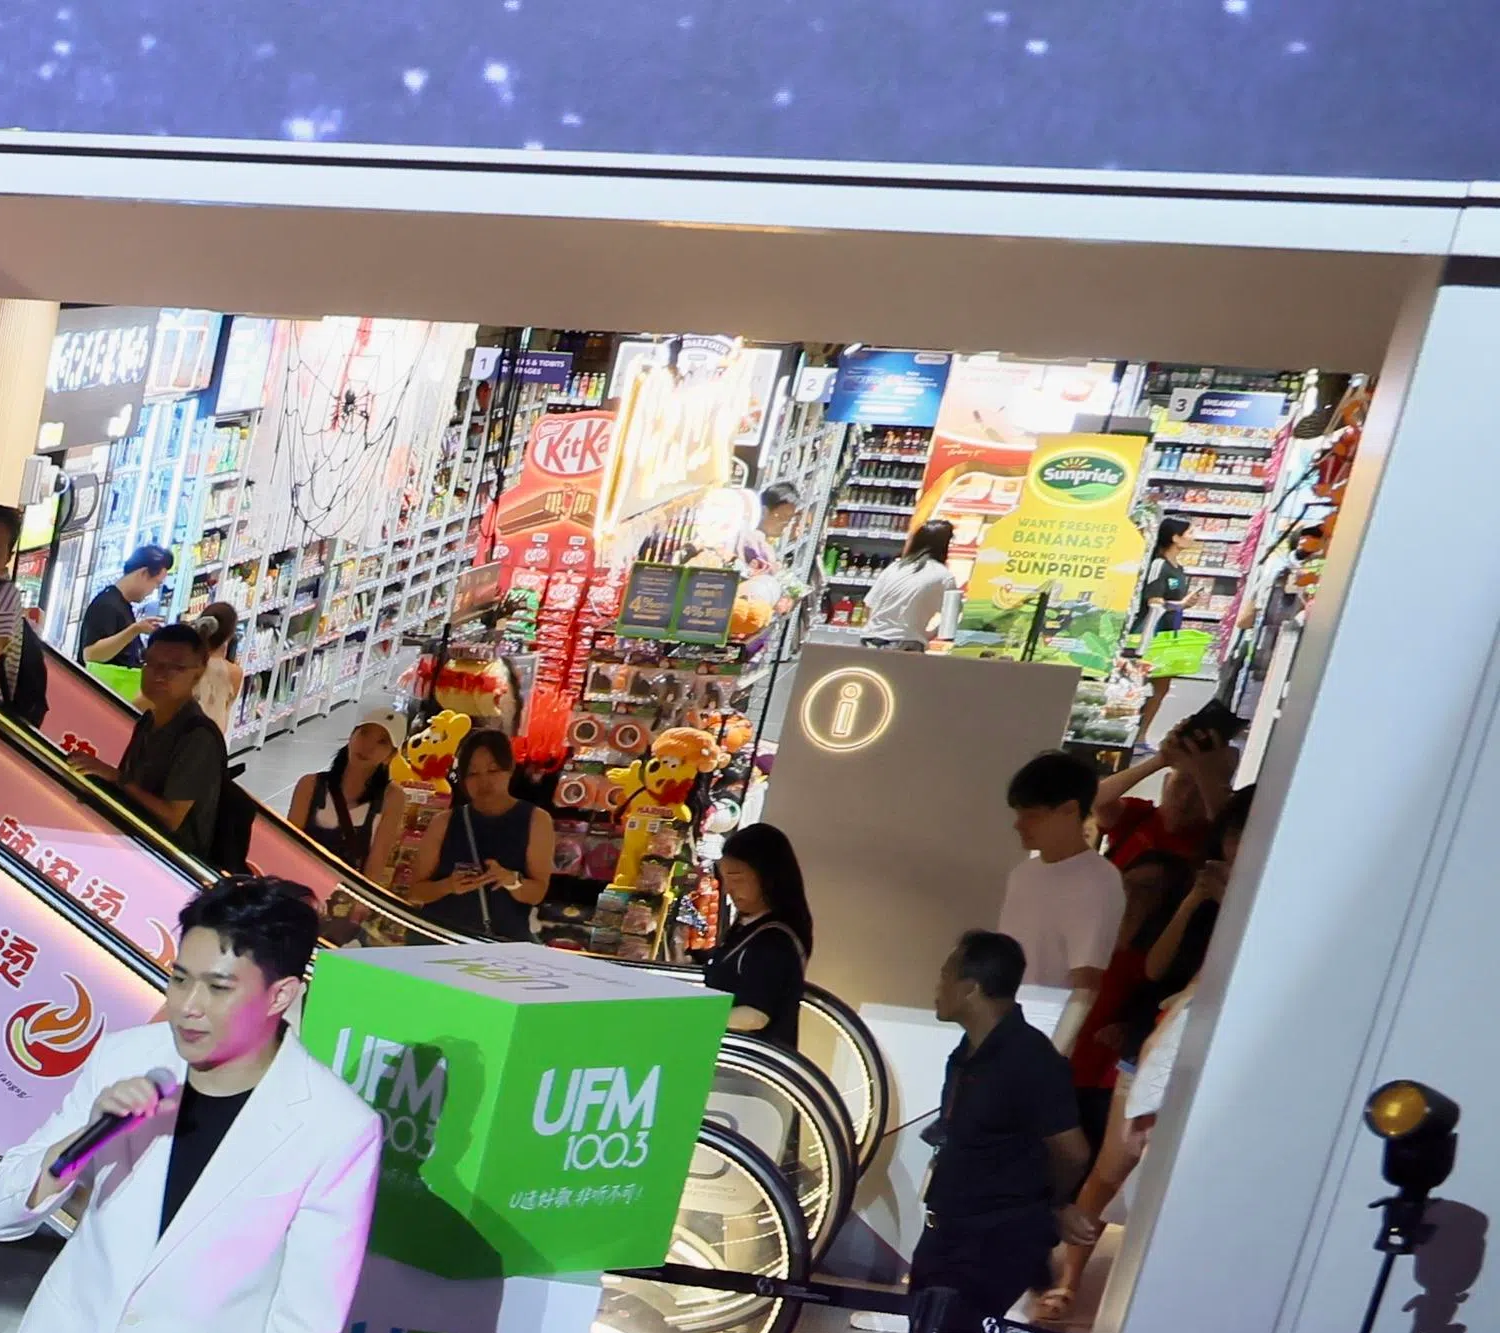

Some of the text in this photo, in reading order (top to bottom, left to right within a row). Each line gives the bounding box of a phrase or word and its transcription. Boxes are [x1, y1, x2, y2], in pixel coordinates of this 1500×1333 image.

[479, 358, 488, 371] 1
[805, 378, 817, 392] 2
[1176, 399, 1187, 413] 3
[1043, 467, 1120, 485] Sunpride
[1019, 518, 1118, 533] WANT FRESHER
[1013, 530, 1115, 549] BANANAS?
[1008, 550, 1037, 560] LOOK
[1040, 552, 1056, 561] NO
[1005, 560, 1108, 580] SUNPRIDE
[531, 1064, 661, 1135] UFM
[563, 1125, 651, 1171] 100.3
